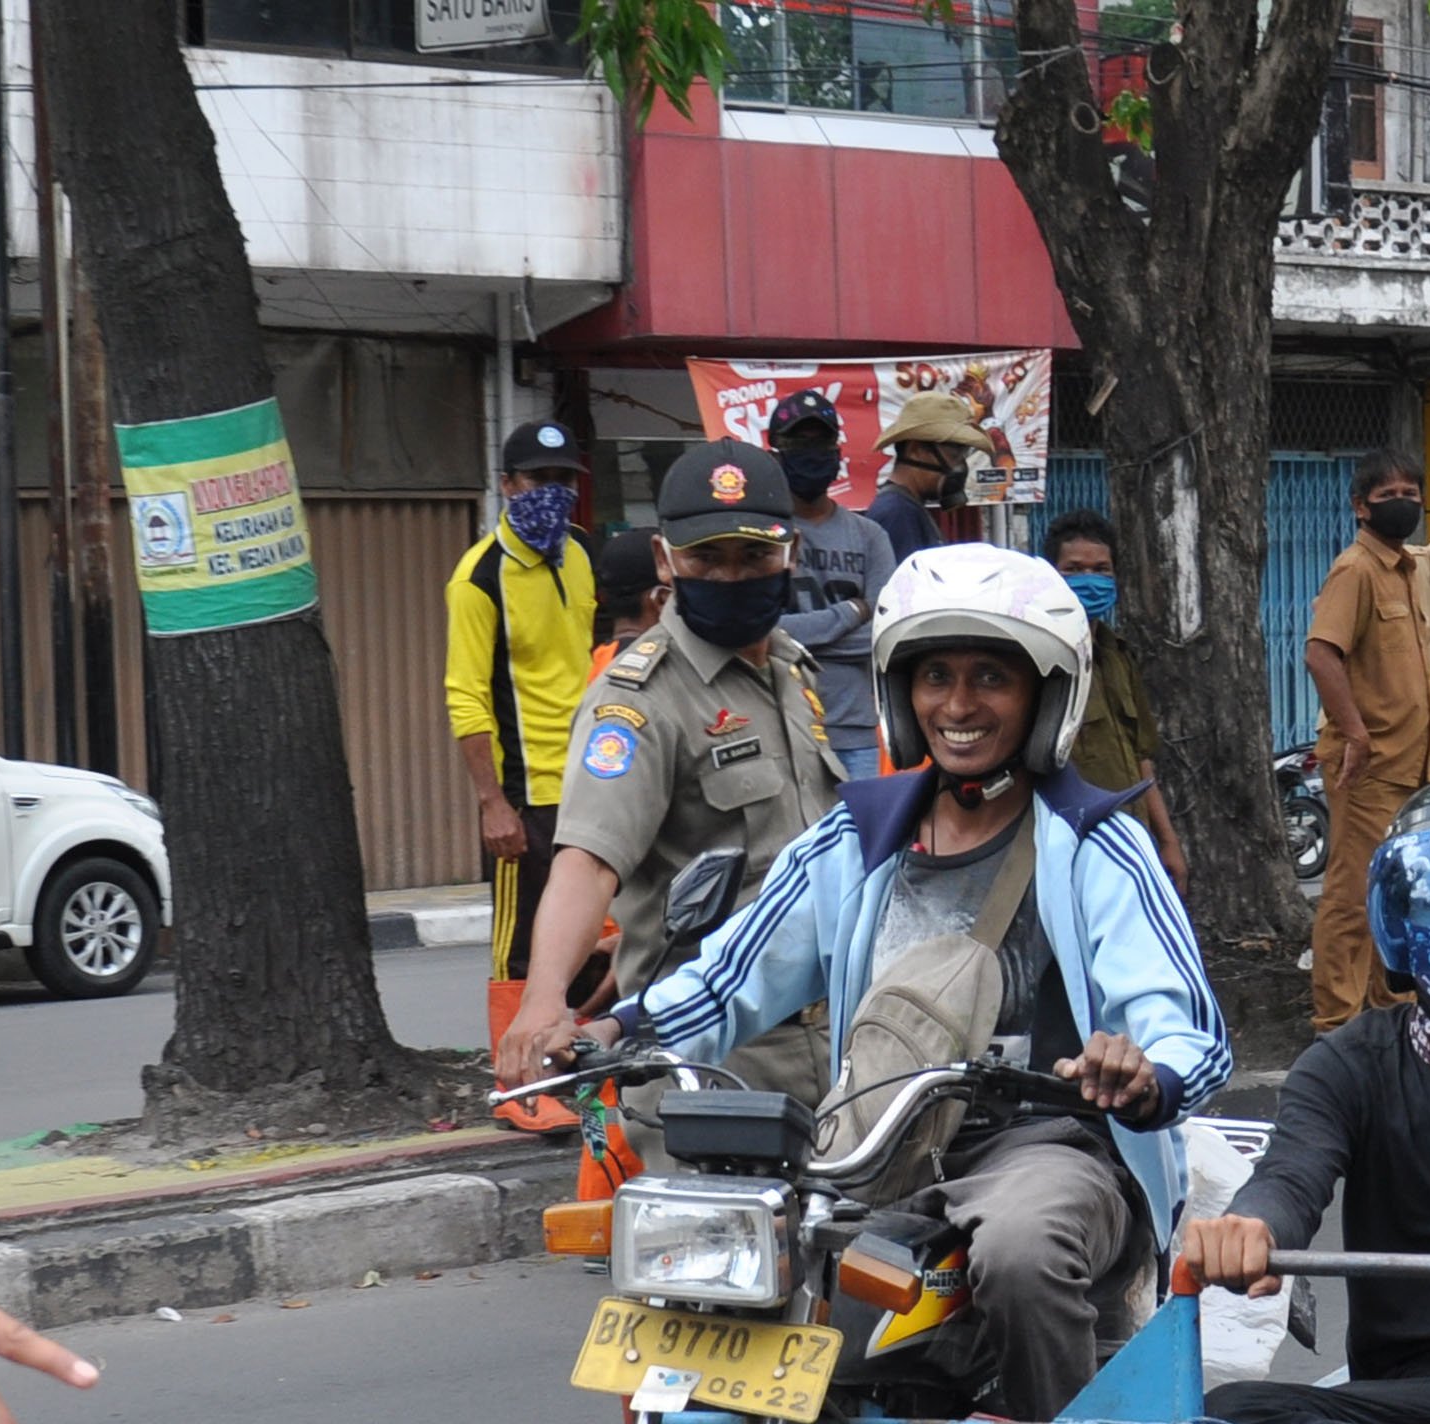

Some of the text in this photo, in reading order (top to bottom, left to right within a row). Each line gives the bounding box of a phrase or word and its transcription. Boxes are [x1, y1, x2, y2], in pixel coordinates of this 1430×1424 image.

[717, 380, 776, 408] PROMO
[594, 1310, 831, 1375] BK 9770 CZ
